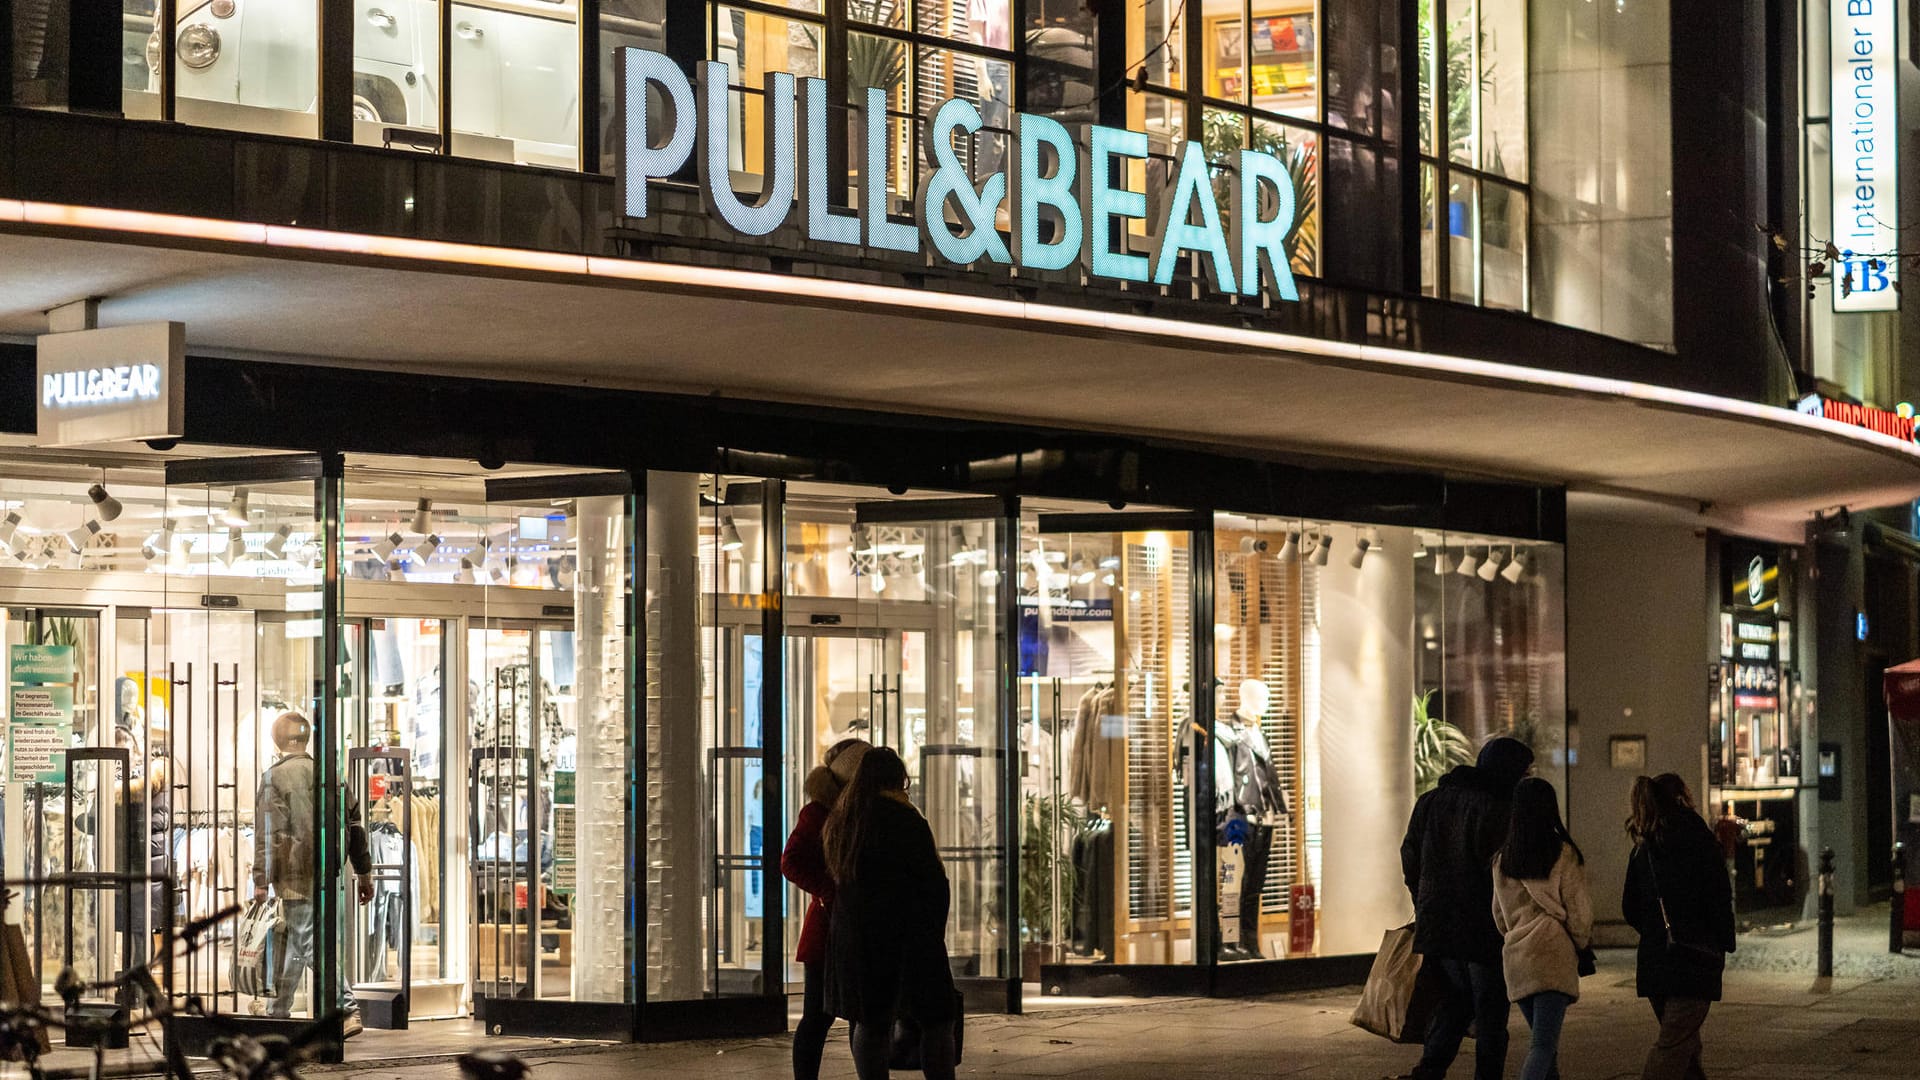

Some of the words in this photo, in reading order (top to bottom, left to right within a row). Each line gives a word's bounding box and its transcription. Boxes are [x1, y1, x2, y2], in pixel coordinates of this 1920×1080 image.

[618, 46, 1300, 301] PULL&BEAR
[1849, 28, 1875, 237] Internationaler
[43, 363, 159, 406] PULL&BEAR
